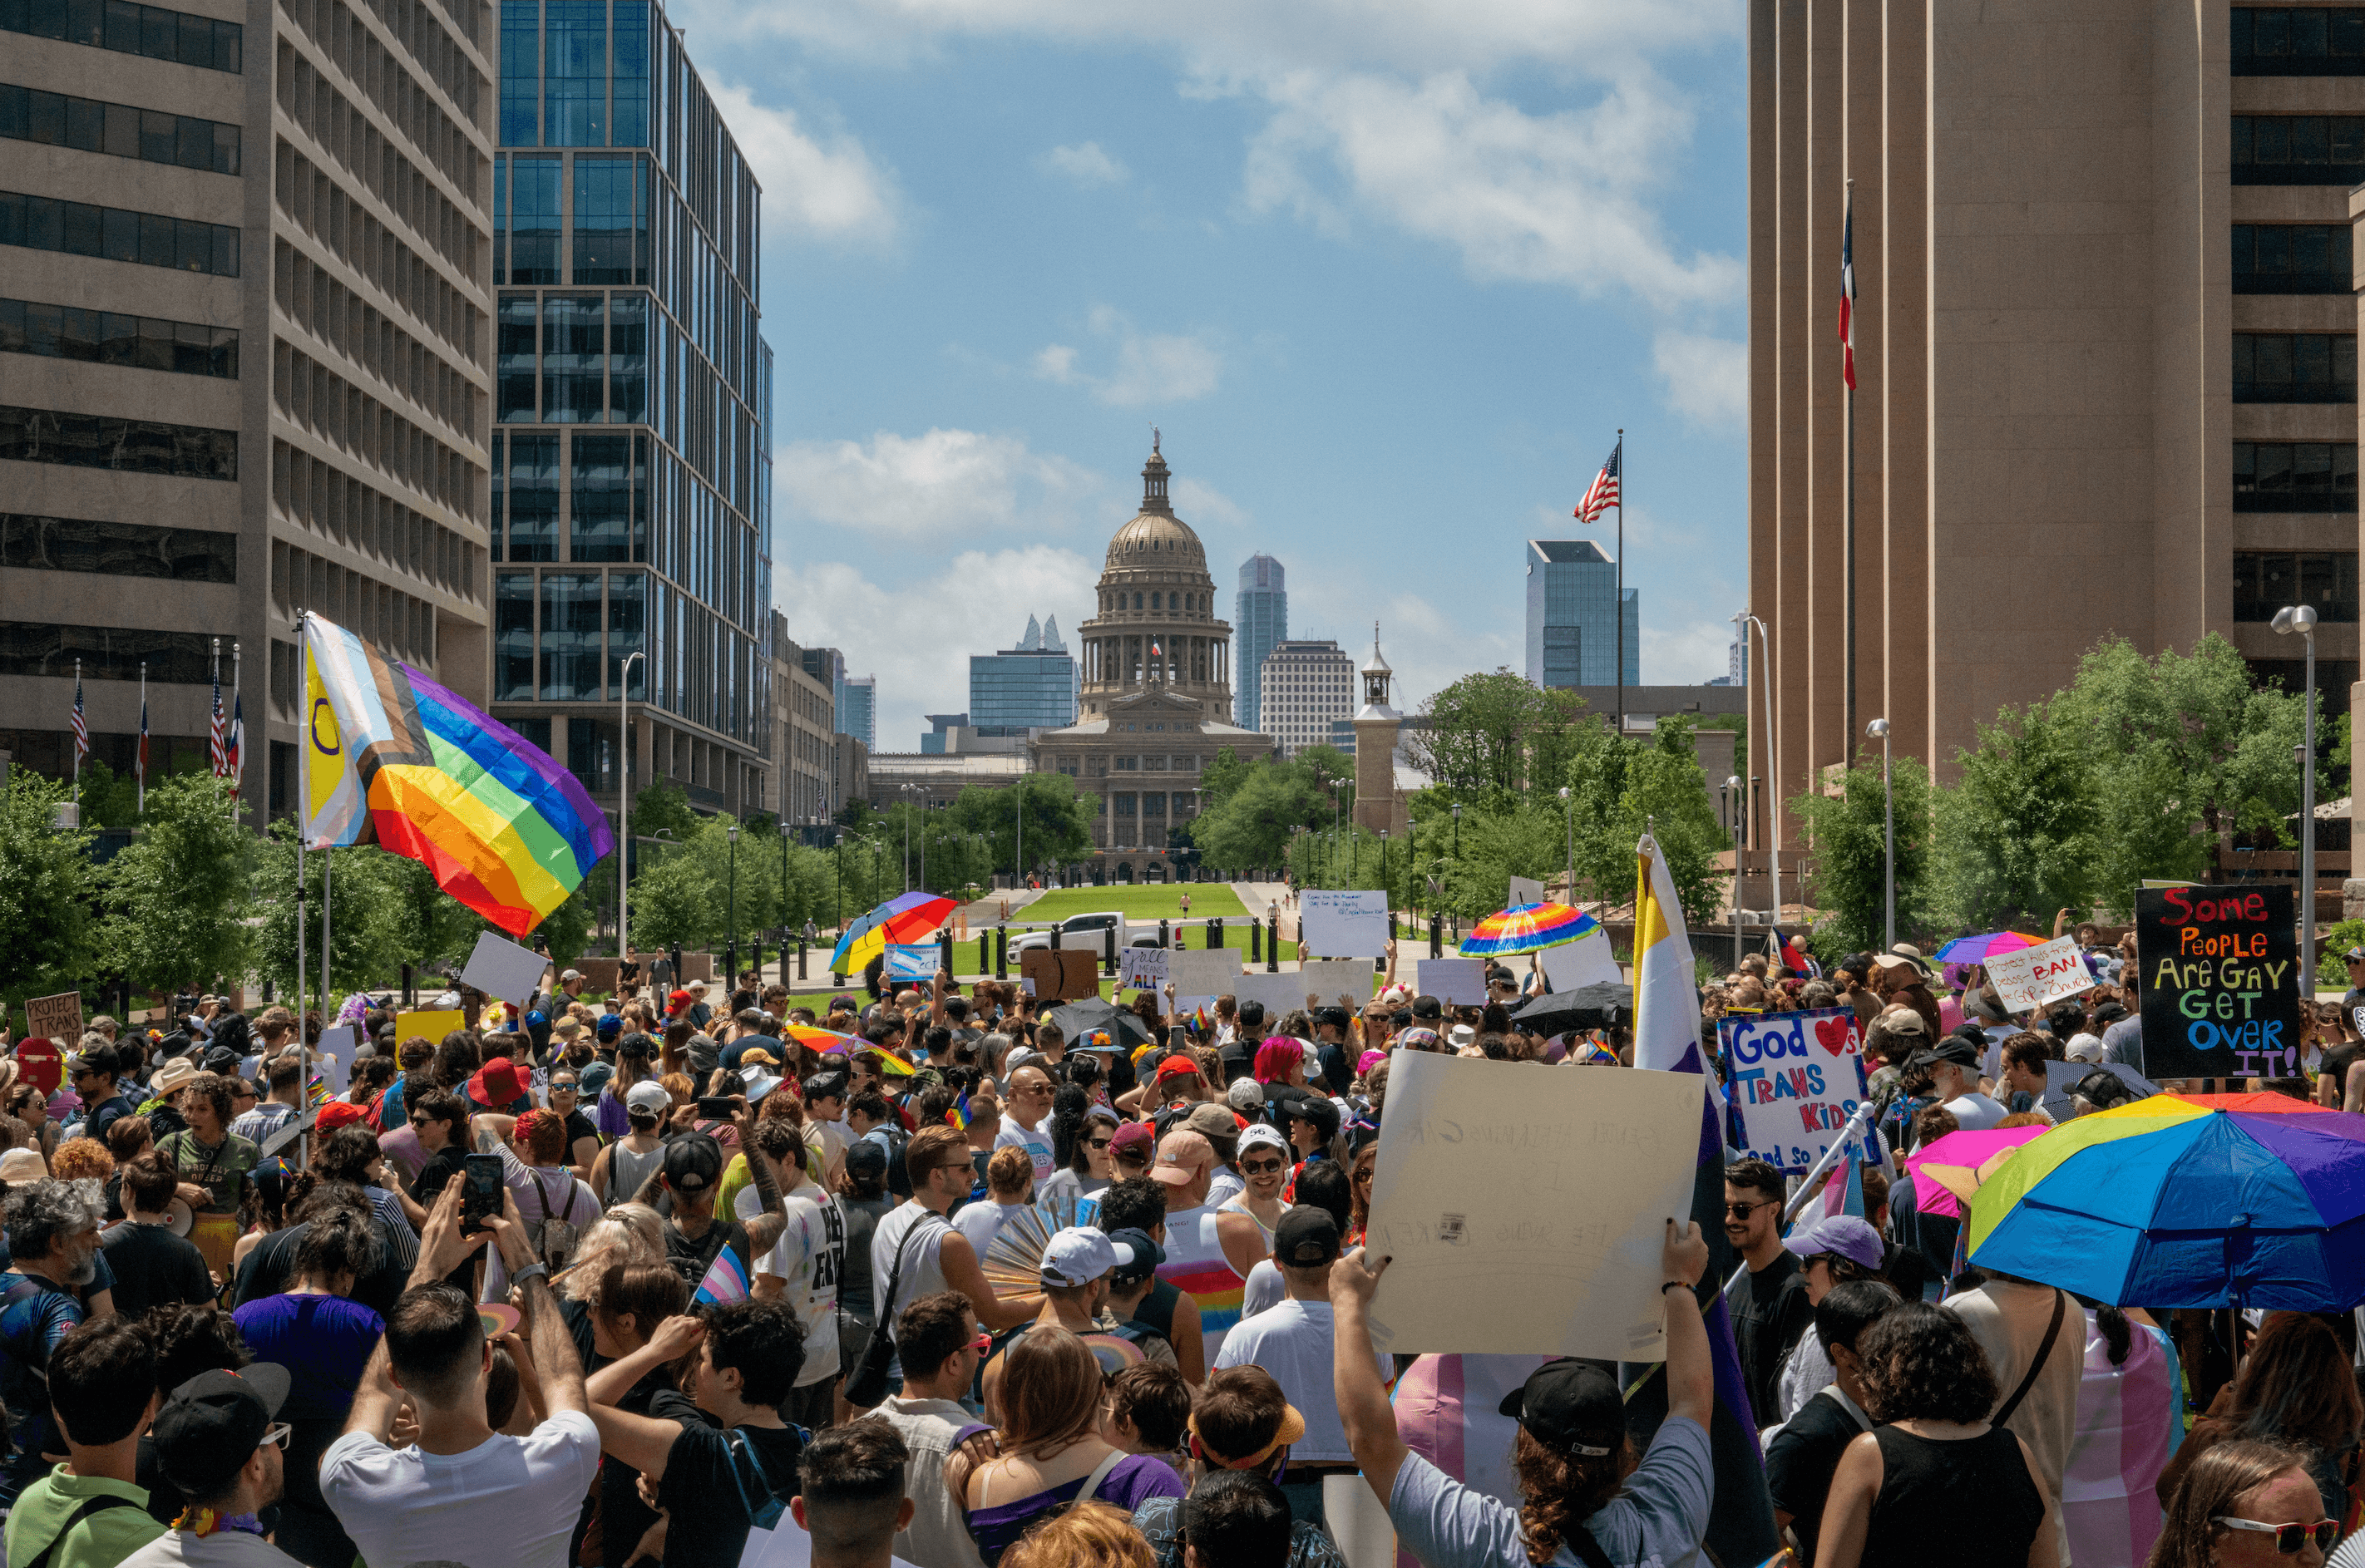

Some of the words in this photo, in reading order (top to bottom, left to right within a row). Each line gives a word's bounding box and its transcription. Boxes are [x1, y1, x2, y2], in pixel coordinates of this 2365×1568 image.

[2160, 888, 2269, 926] Some
[1139, 964, 1163, 974] MEANS
[2032, 955, 2076, 980] BAN
[2013, 985, 2037, 1003] GOP
[2049, 973, 2093, 996] Church
[27, 994, 78, 1018] PROTECT
[34, 1013, 79, 1036] TRANS
[1733, 1018, 1809, 1064] God
[2233, 1046, 2297, 1078] IT!
